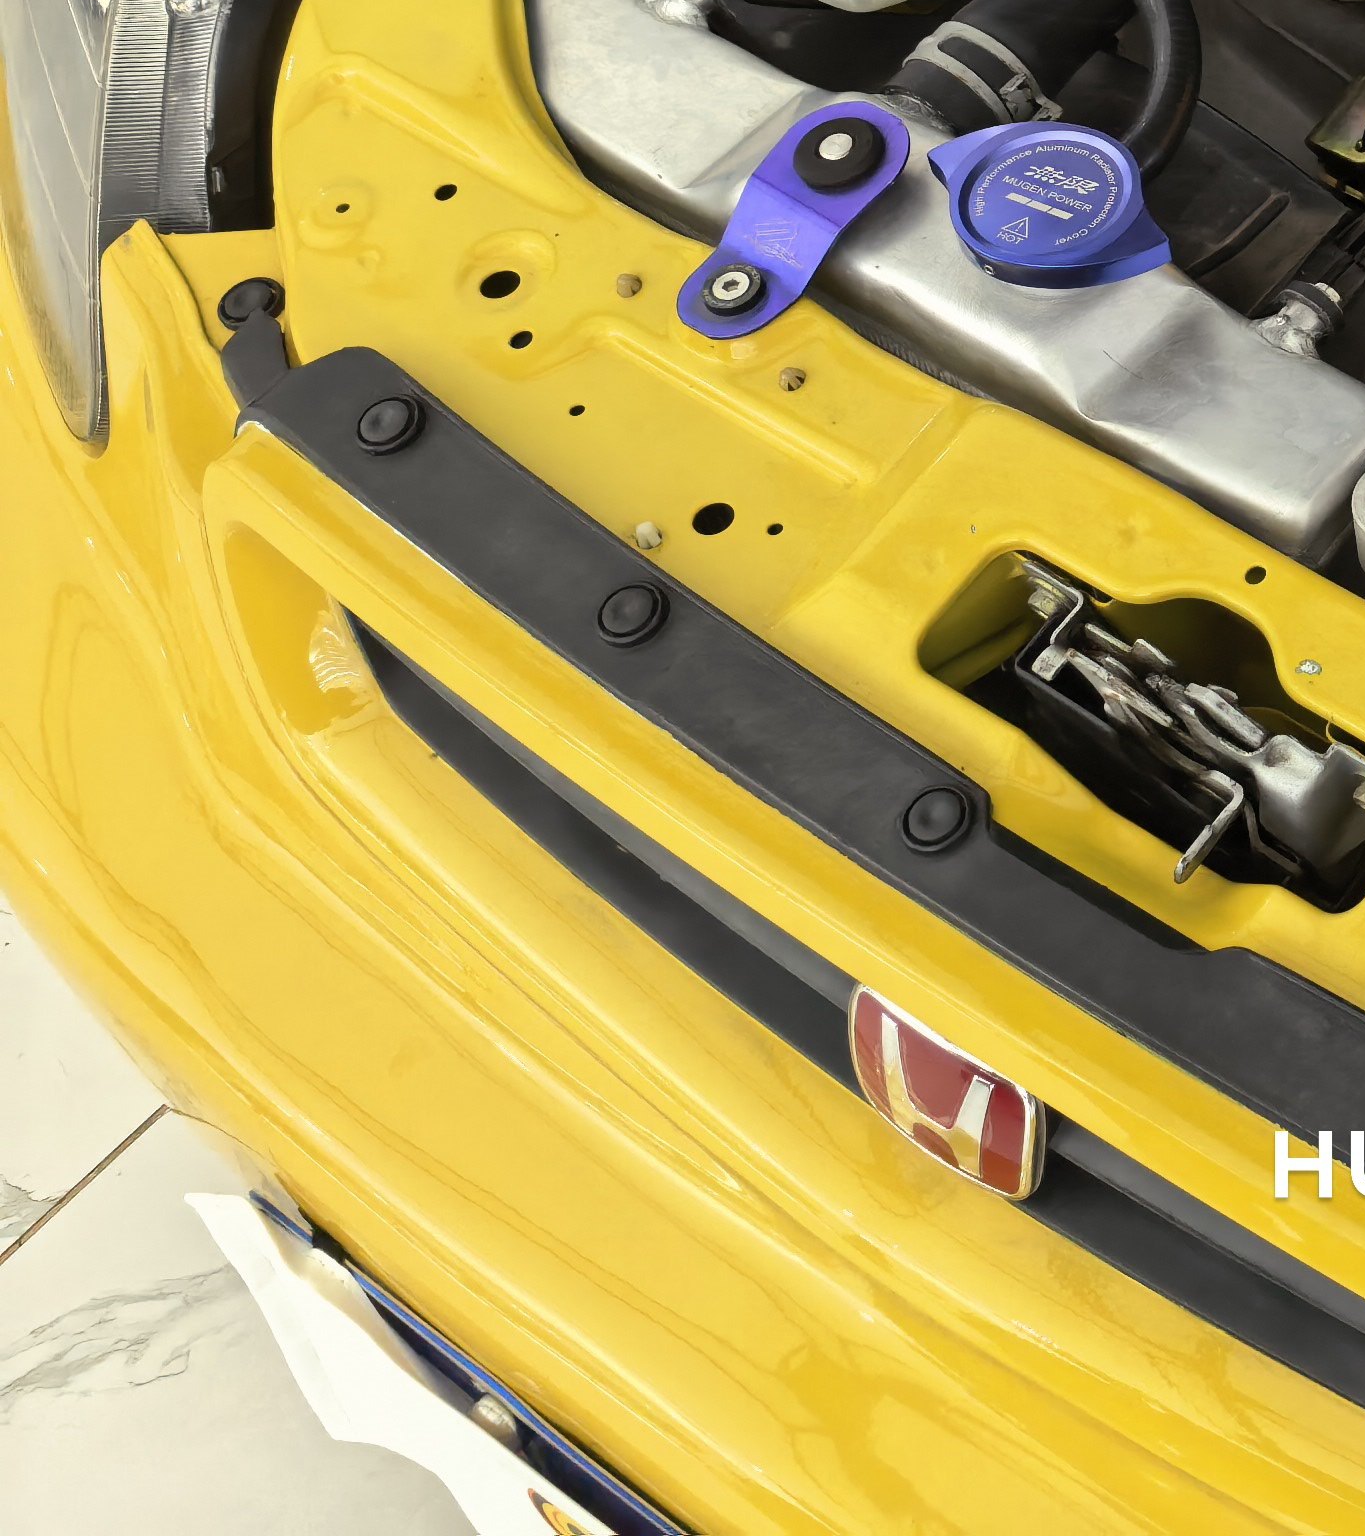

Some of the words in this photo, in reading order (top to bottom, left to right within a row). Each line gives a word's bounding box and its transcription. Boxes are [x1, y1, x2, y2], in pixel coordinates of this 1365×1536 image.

[1035, 144, 1090, 158] Aluminum
[1002, 175, 1048, 197] MUGEN
[1047, 191, 1093, 213] POWER
[996, 231, 1025, 245] HOT
[1054, 228, 1089, 246] Cover
